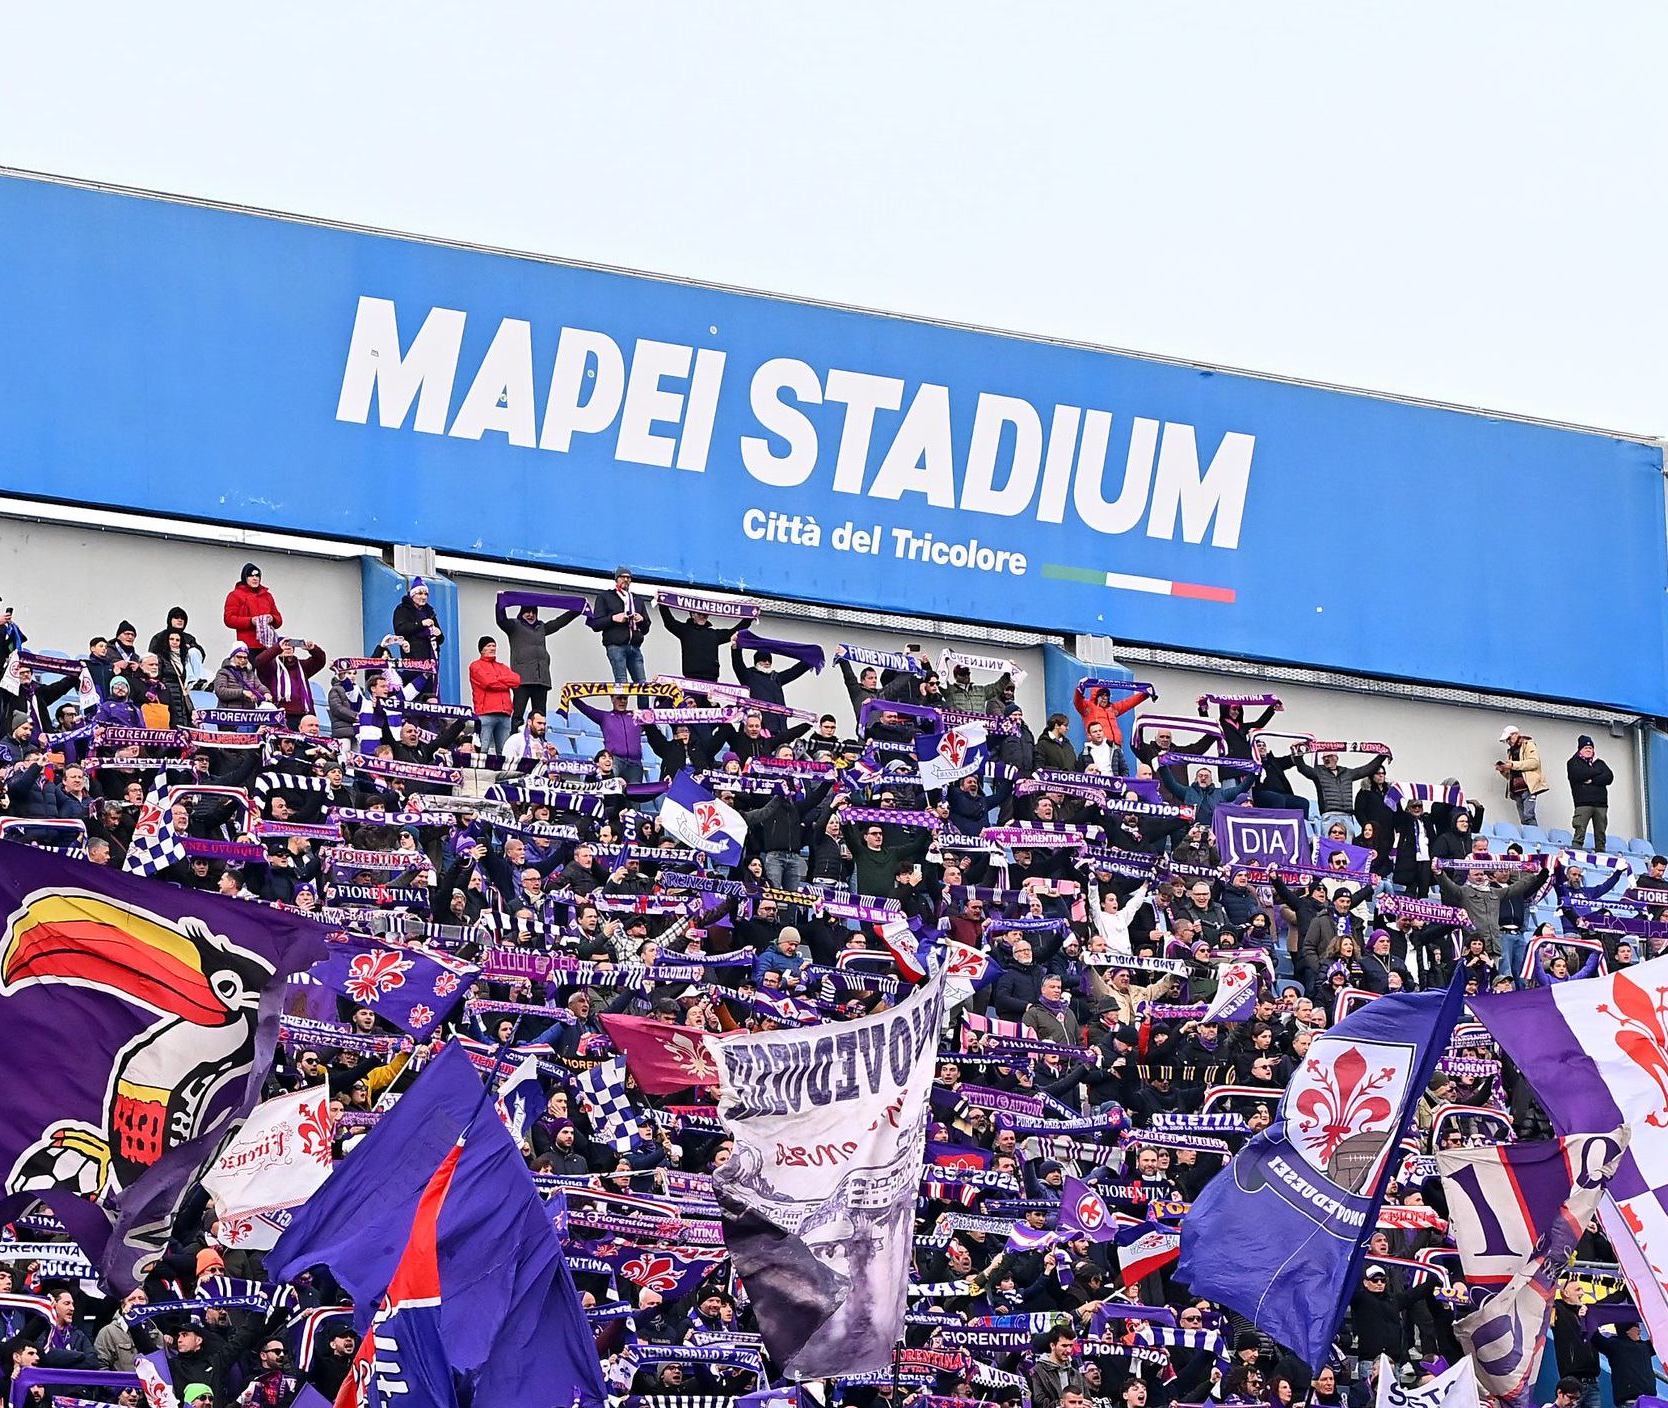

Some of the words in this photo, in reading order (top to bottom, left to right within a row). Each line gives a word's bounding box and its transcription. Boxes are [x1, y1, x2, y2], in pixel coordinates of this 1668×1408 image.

[336, 295, 726, 472] MAPEI
[741, 357, 1255, 549] STADIUM
[743, 508, 822, 550] Città
[833, 521, 880, 555] del
[890, 527, 1028, 576] Tricolore
[848, 645, 909, 672] FIORENTINA
[210, 709, 271, 724] FIORENTINA
[106, 728, 175, 743] FIORENTINA
[1242, 826, 1288, 856] DIA
[332, 850, 410, 866] FIORENTINA
[336, 885, 424, 904] FIORENTINA
